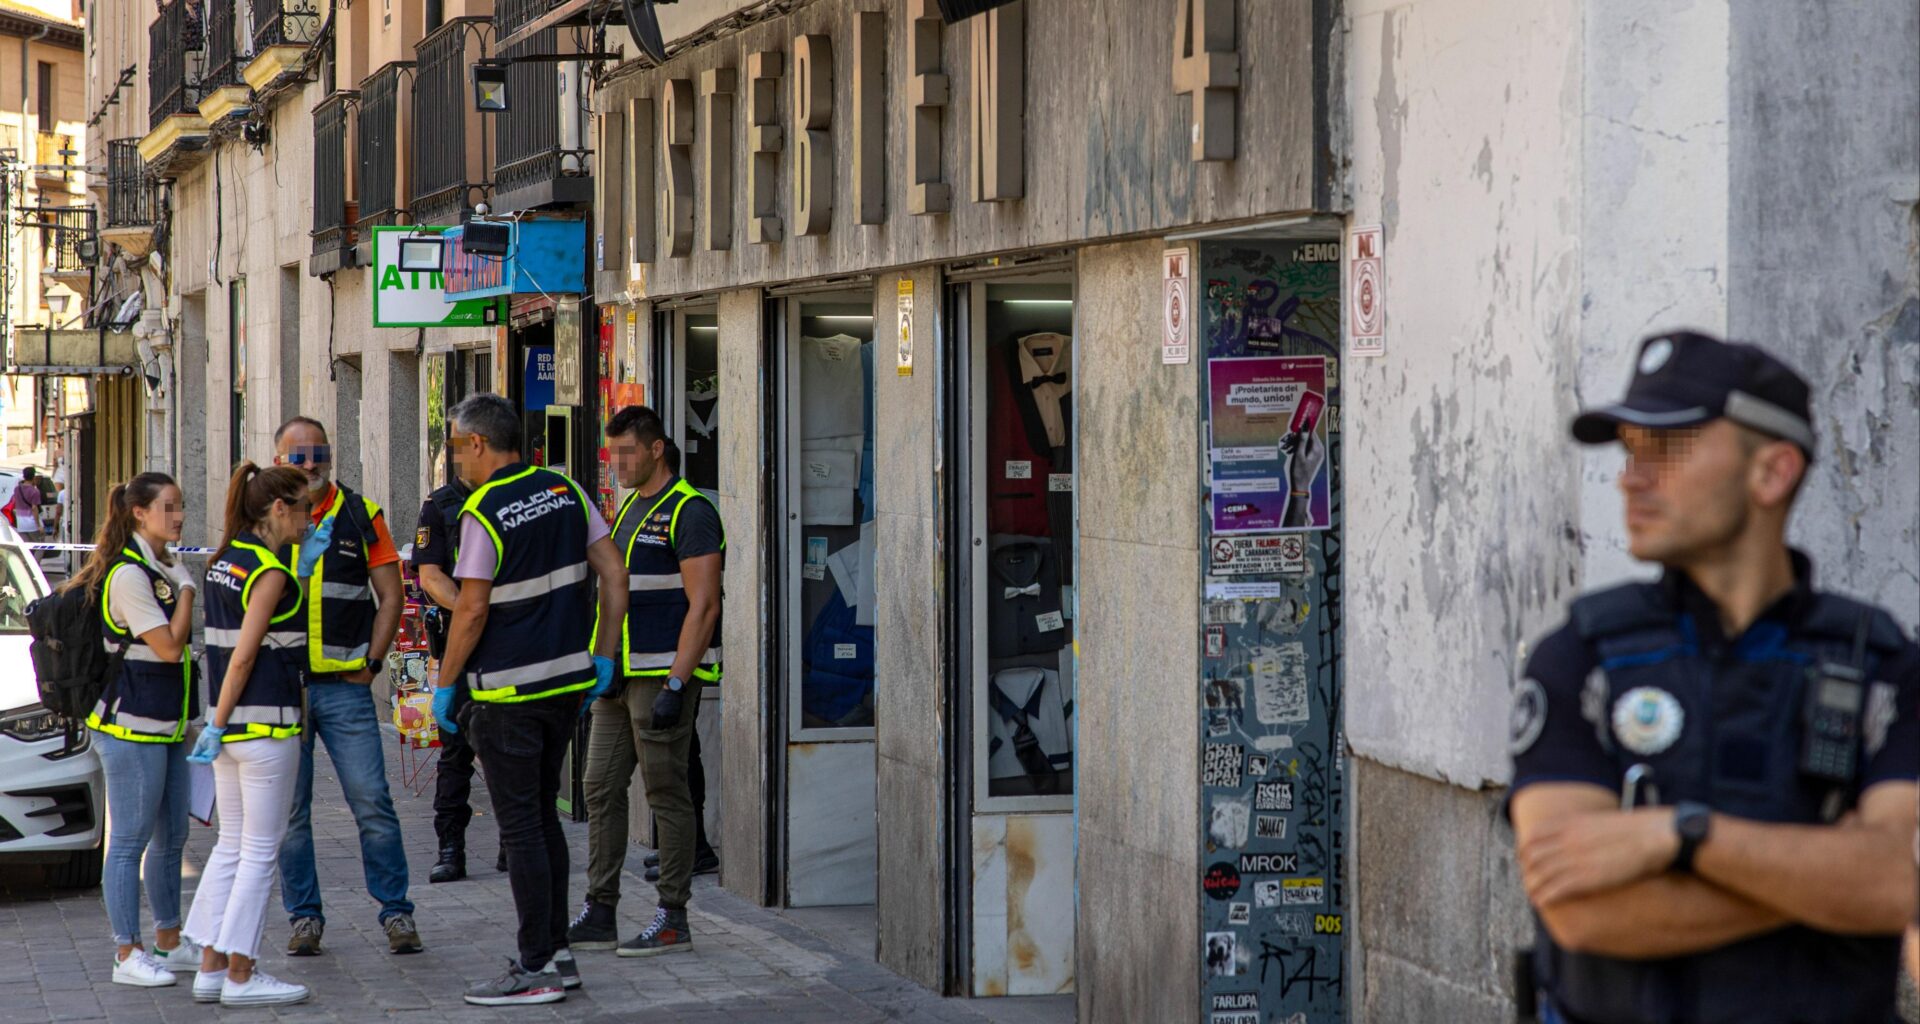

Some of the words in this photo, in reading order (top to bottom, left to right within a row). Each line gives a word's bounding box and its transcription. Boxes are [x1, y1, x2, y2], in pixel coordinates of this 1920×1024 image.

[537, 353, 552, 362] RED
[537, 363, 546, 371] TE
[1284, 385, 1298, 393] del
[1231, 395, 1262, 405] mundo,
[496, 489, 557, 521] POLICIA
[502, 495, 576, 532] NACIONAL
[1234, 540, 1252, 549] FUERA
[1256, 538, 1281, 548] FALANGE
[1235, 549, 1242, 557] DE
[1244, 548, 1281, 557] CARABANCHEL
[1205, 747, 1242, 762] OPAL
[1204, 755, 1242, 772] PUSH
[1203, 766, 1241, 783] OPAL
[1241, 855, 1297, 872] MROK
[1314, 914, 1342, 933] DOS
[1213, 994, 1258, 1008] FARLOPA
